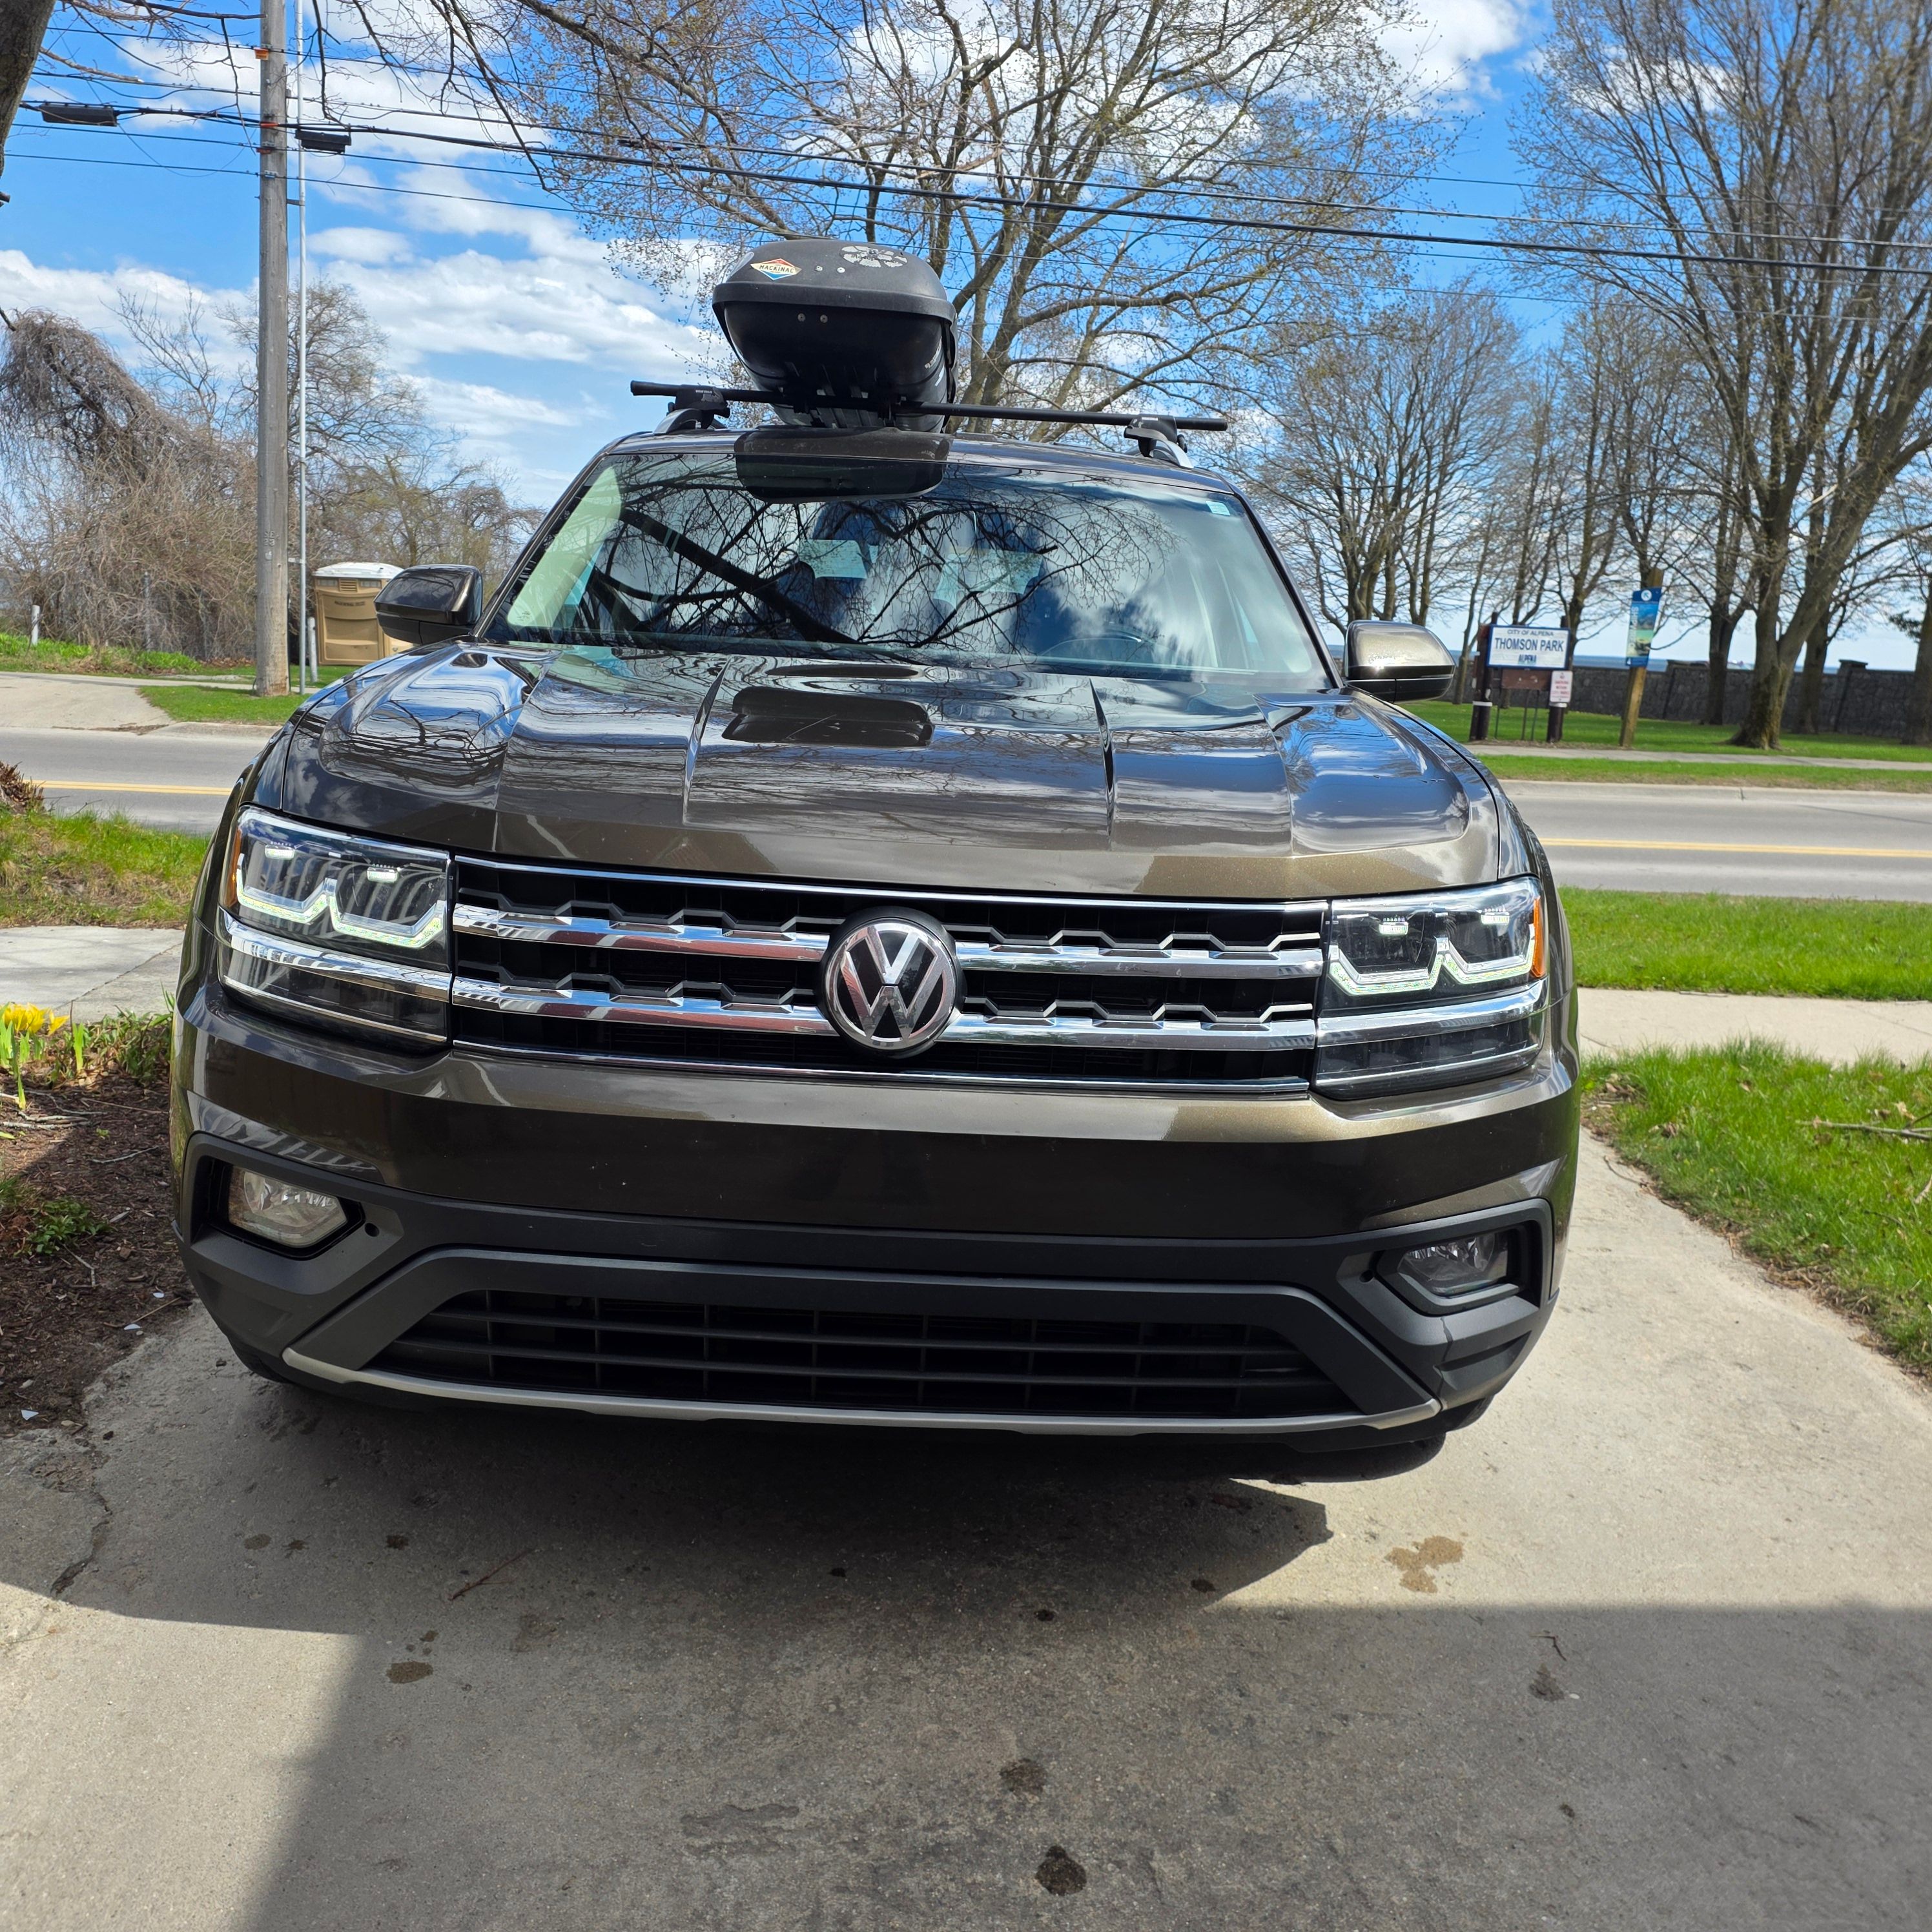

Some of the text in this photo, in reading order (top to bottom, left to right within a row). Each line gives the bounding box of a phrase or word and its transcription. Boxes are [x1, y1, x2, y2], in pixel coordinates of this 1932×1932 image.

[759, 265, 794, 273] MACKINAC
[1495, 637, 1564, 652] THOMSON PARK
